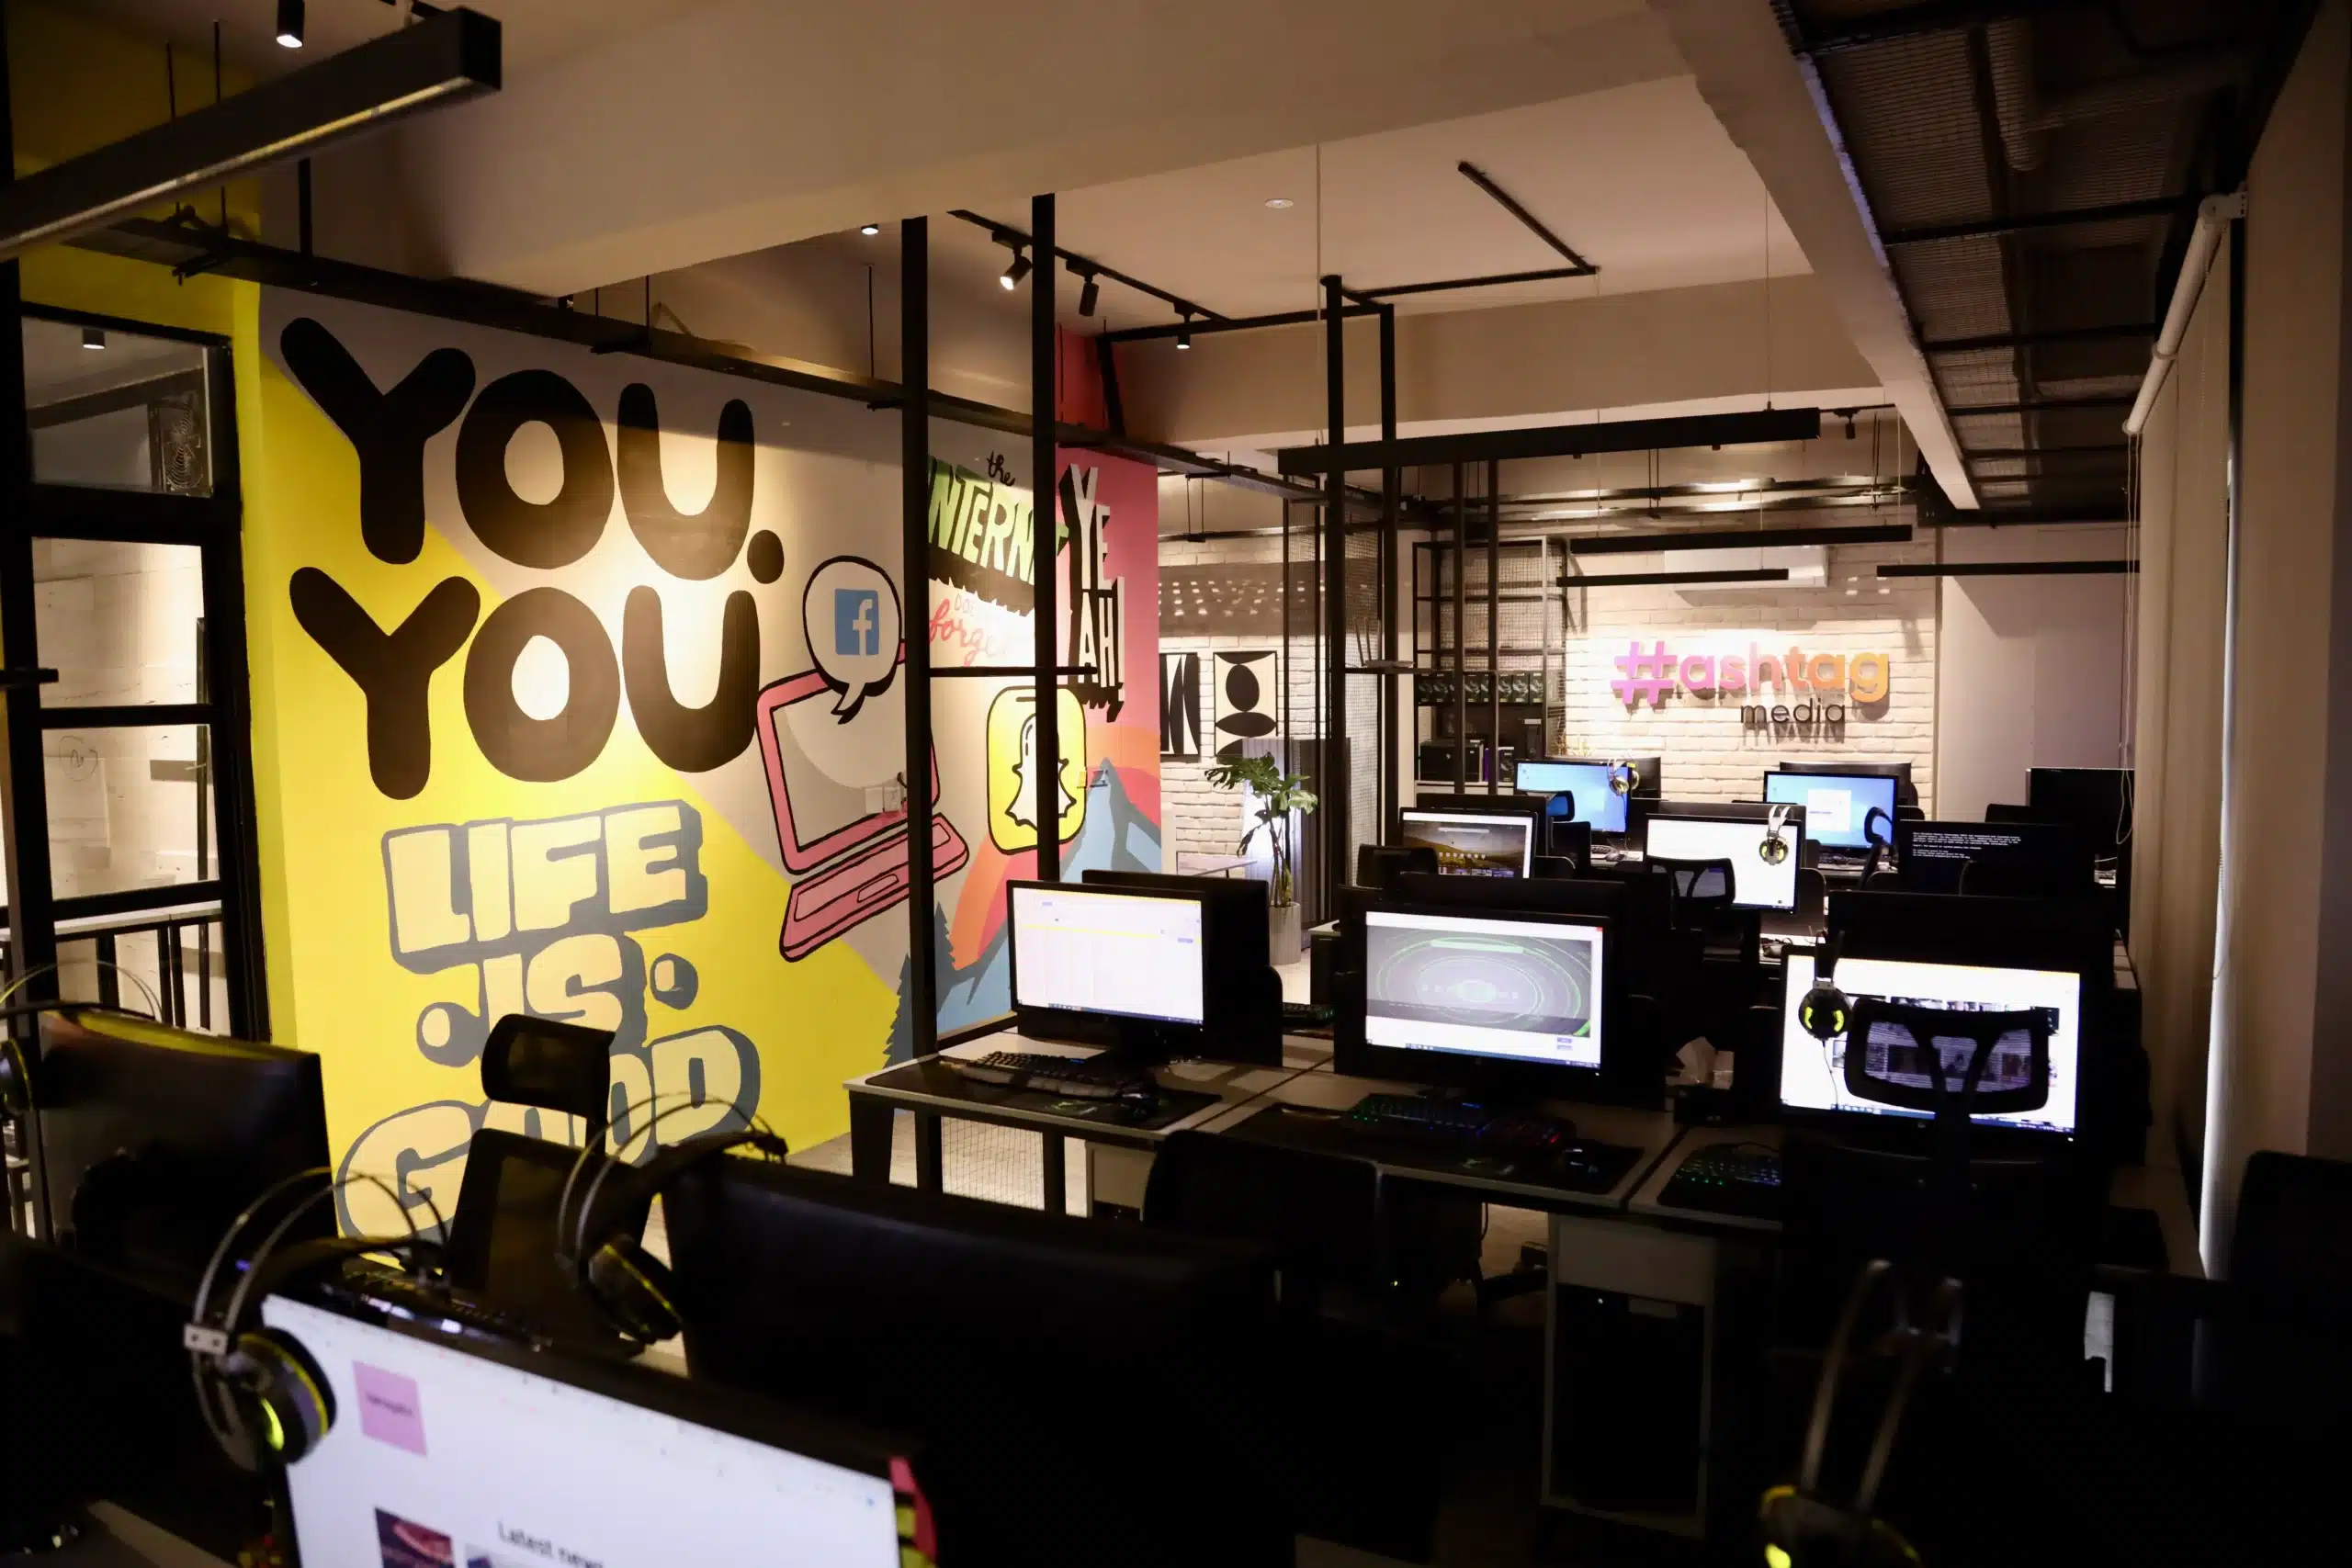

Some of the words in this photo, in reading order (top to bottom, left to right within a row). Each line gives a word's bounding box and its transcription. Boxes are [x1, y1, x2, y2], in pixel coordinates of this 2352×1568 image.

[986, 449, 1016, 487] the
[928, 456, 1069, 586] NTERN
[288, 566, 761, 801] YOU
[1610, 640, 1890, 704] #ashtag
[1740, 698, 1846, 724] media
[382, 800, 707, 974] LIFE
